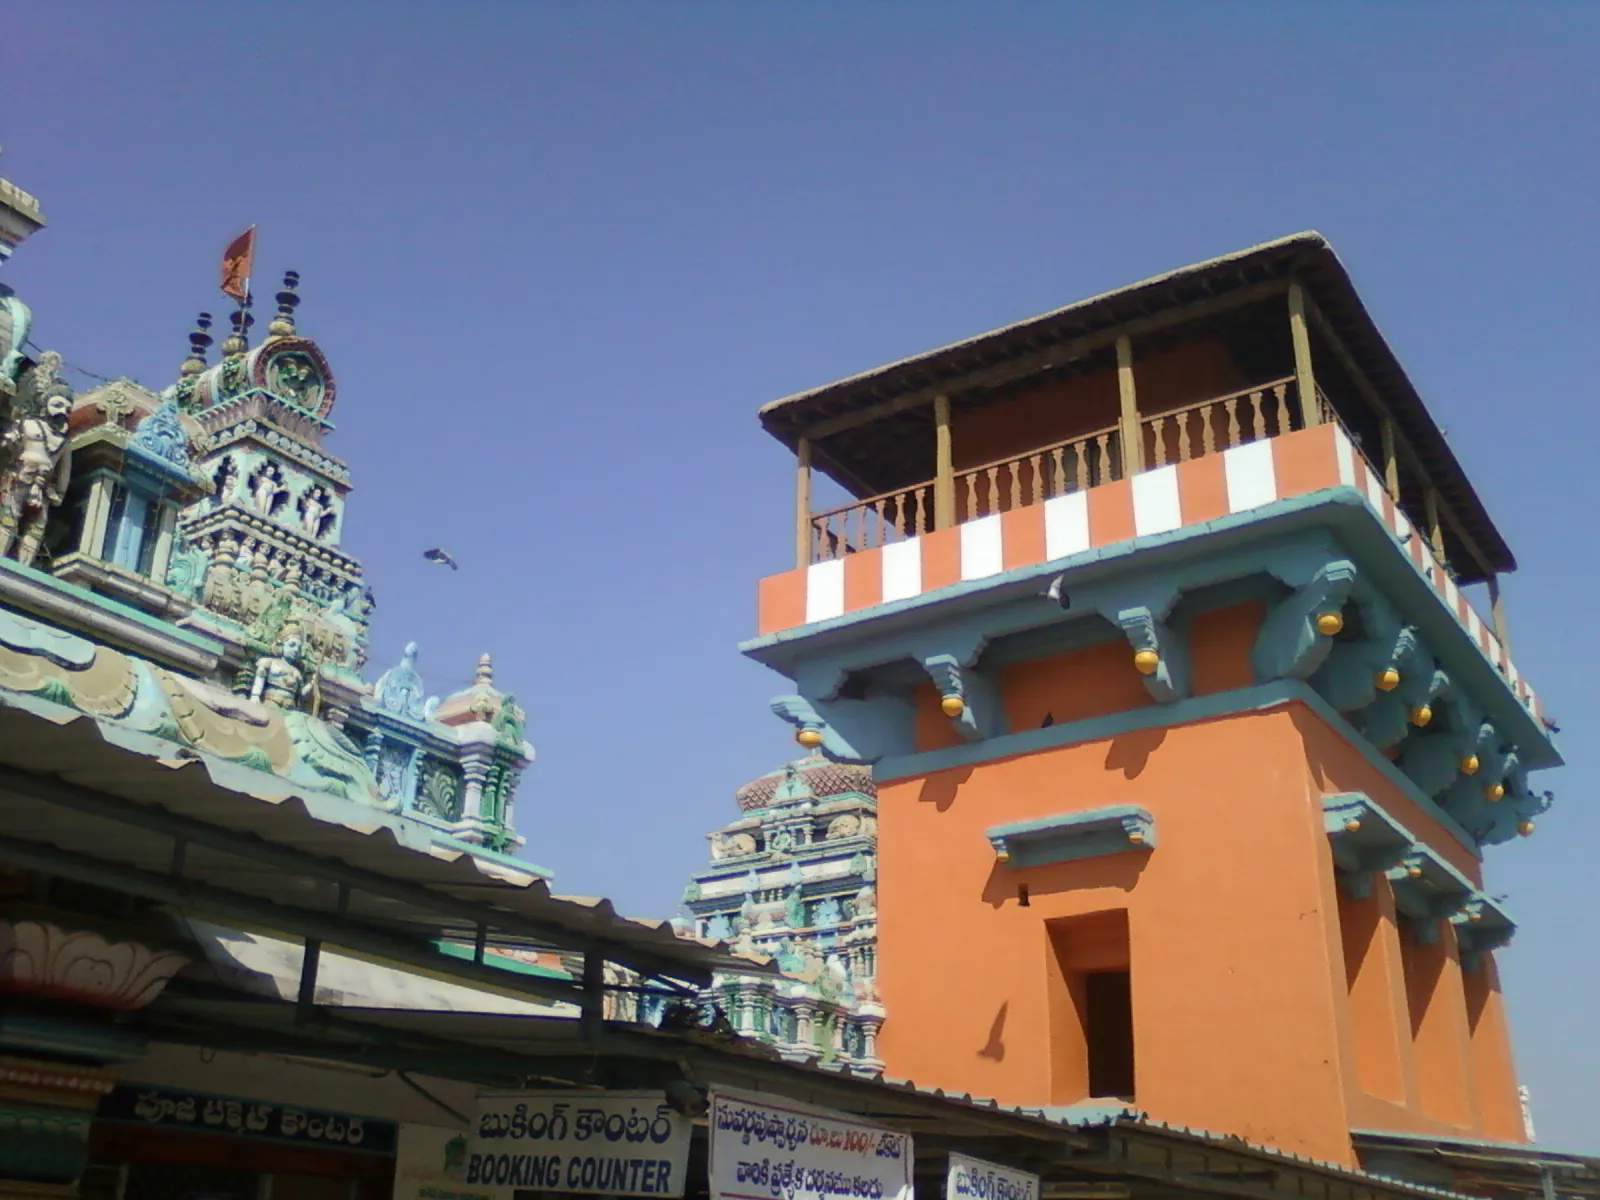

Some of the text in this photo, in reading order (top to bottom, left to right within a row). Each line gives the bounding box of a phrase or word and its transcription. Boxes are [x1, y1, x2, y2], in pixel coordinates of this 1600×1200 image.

[478, 1103, 570, 1140] బుకింగ్
[467, 1154, 672, 1193] BOOKING COUNTER
